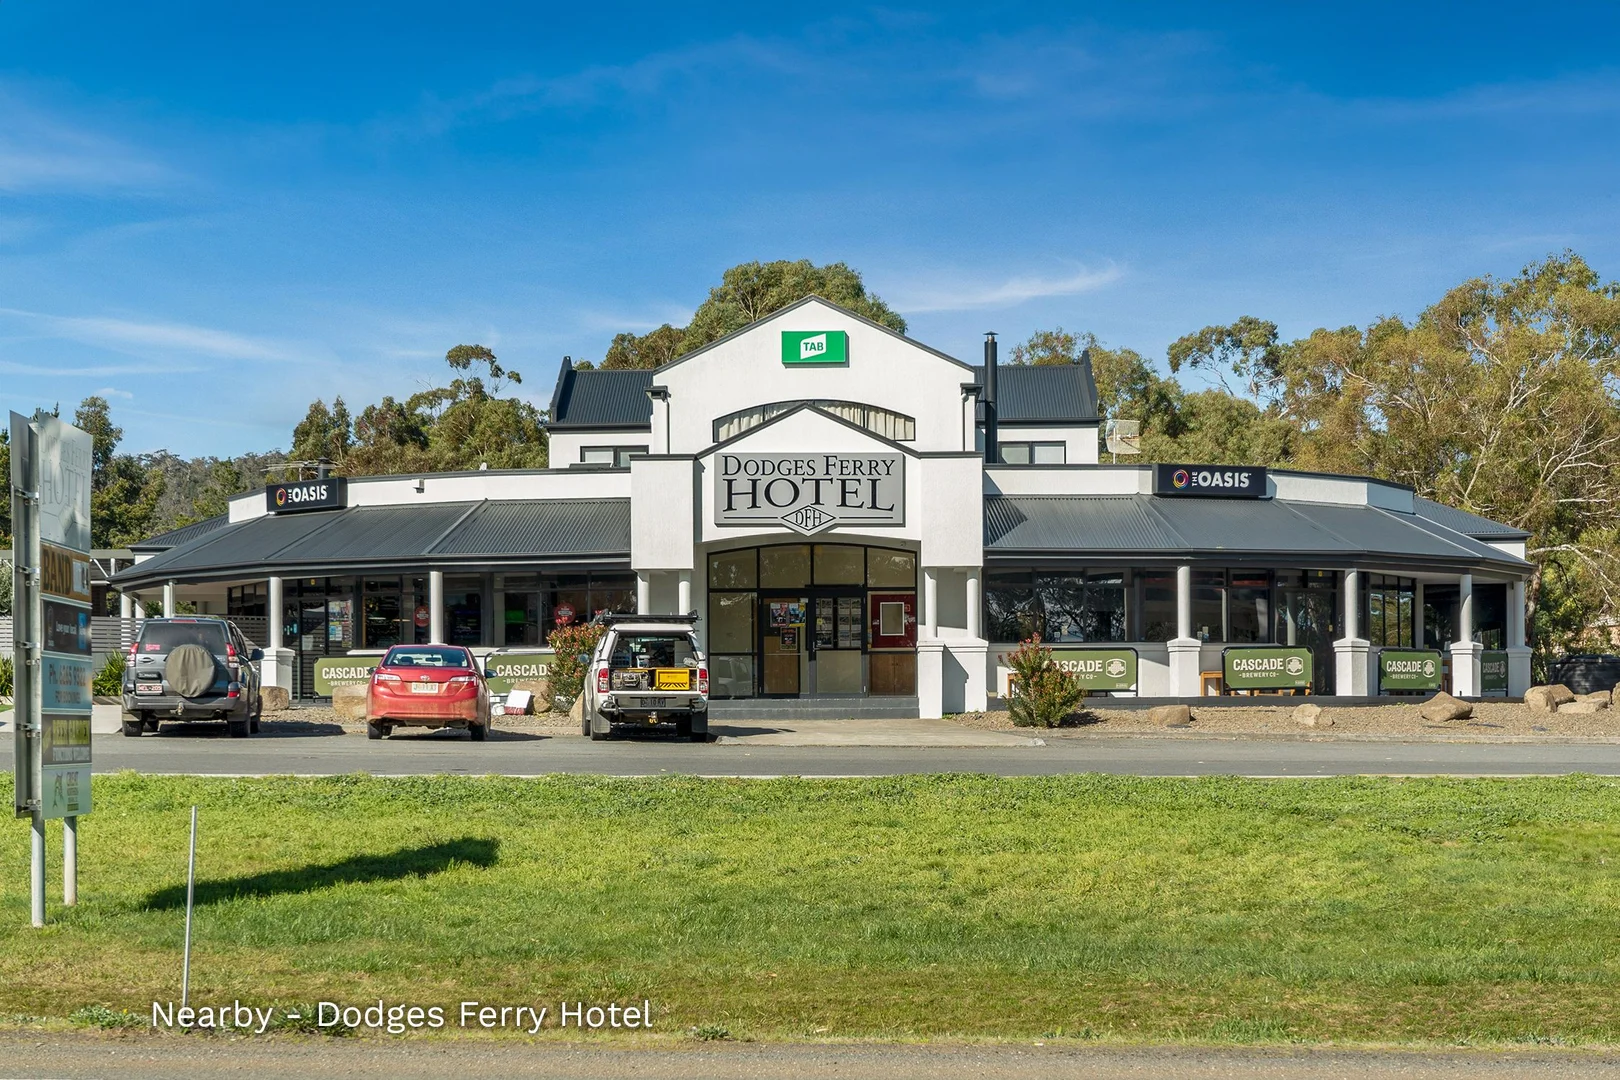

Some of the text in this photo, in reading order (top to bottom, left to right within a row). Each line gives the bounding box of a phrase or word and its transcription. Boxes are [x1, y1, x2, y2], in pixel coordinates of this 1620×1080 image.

[803, 341, 824, 352] TAB
[722, 455, 896, 476] DODGES FERRY
[1198, 471, 1250, 488] OASIS
[292, 485, 327, 502] OASIS
[722, 477, 895, 512] HOTEL
[795, 508, 822, 527] DFH
[322, 667, 371, 679] CASCADE
[1233, 658, 1284, 671] CASCADE
[1386, 660, 1422, 672] CASCADE
